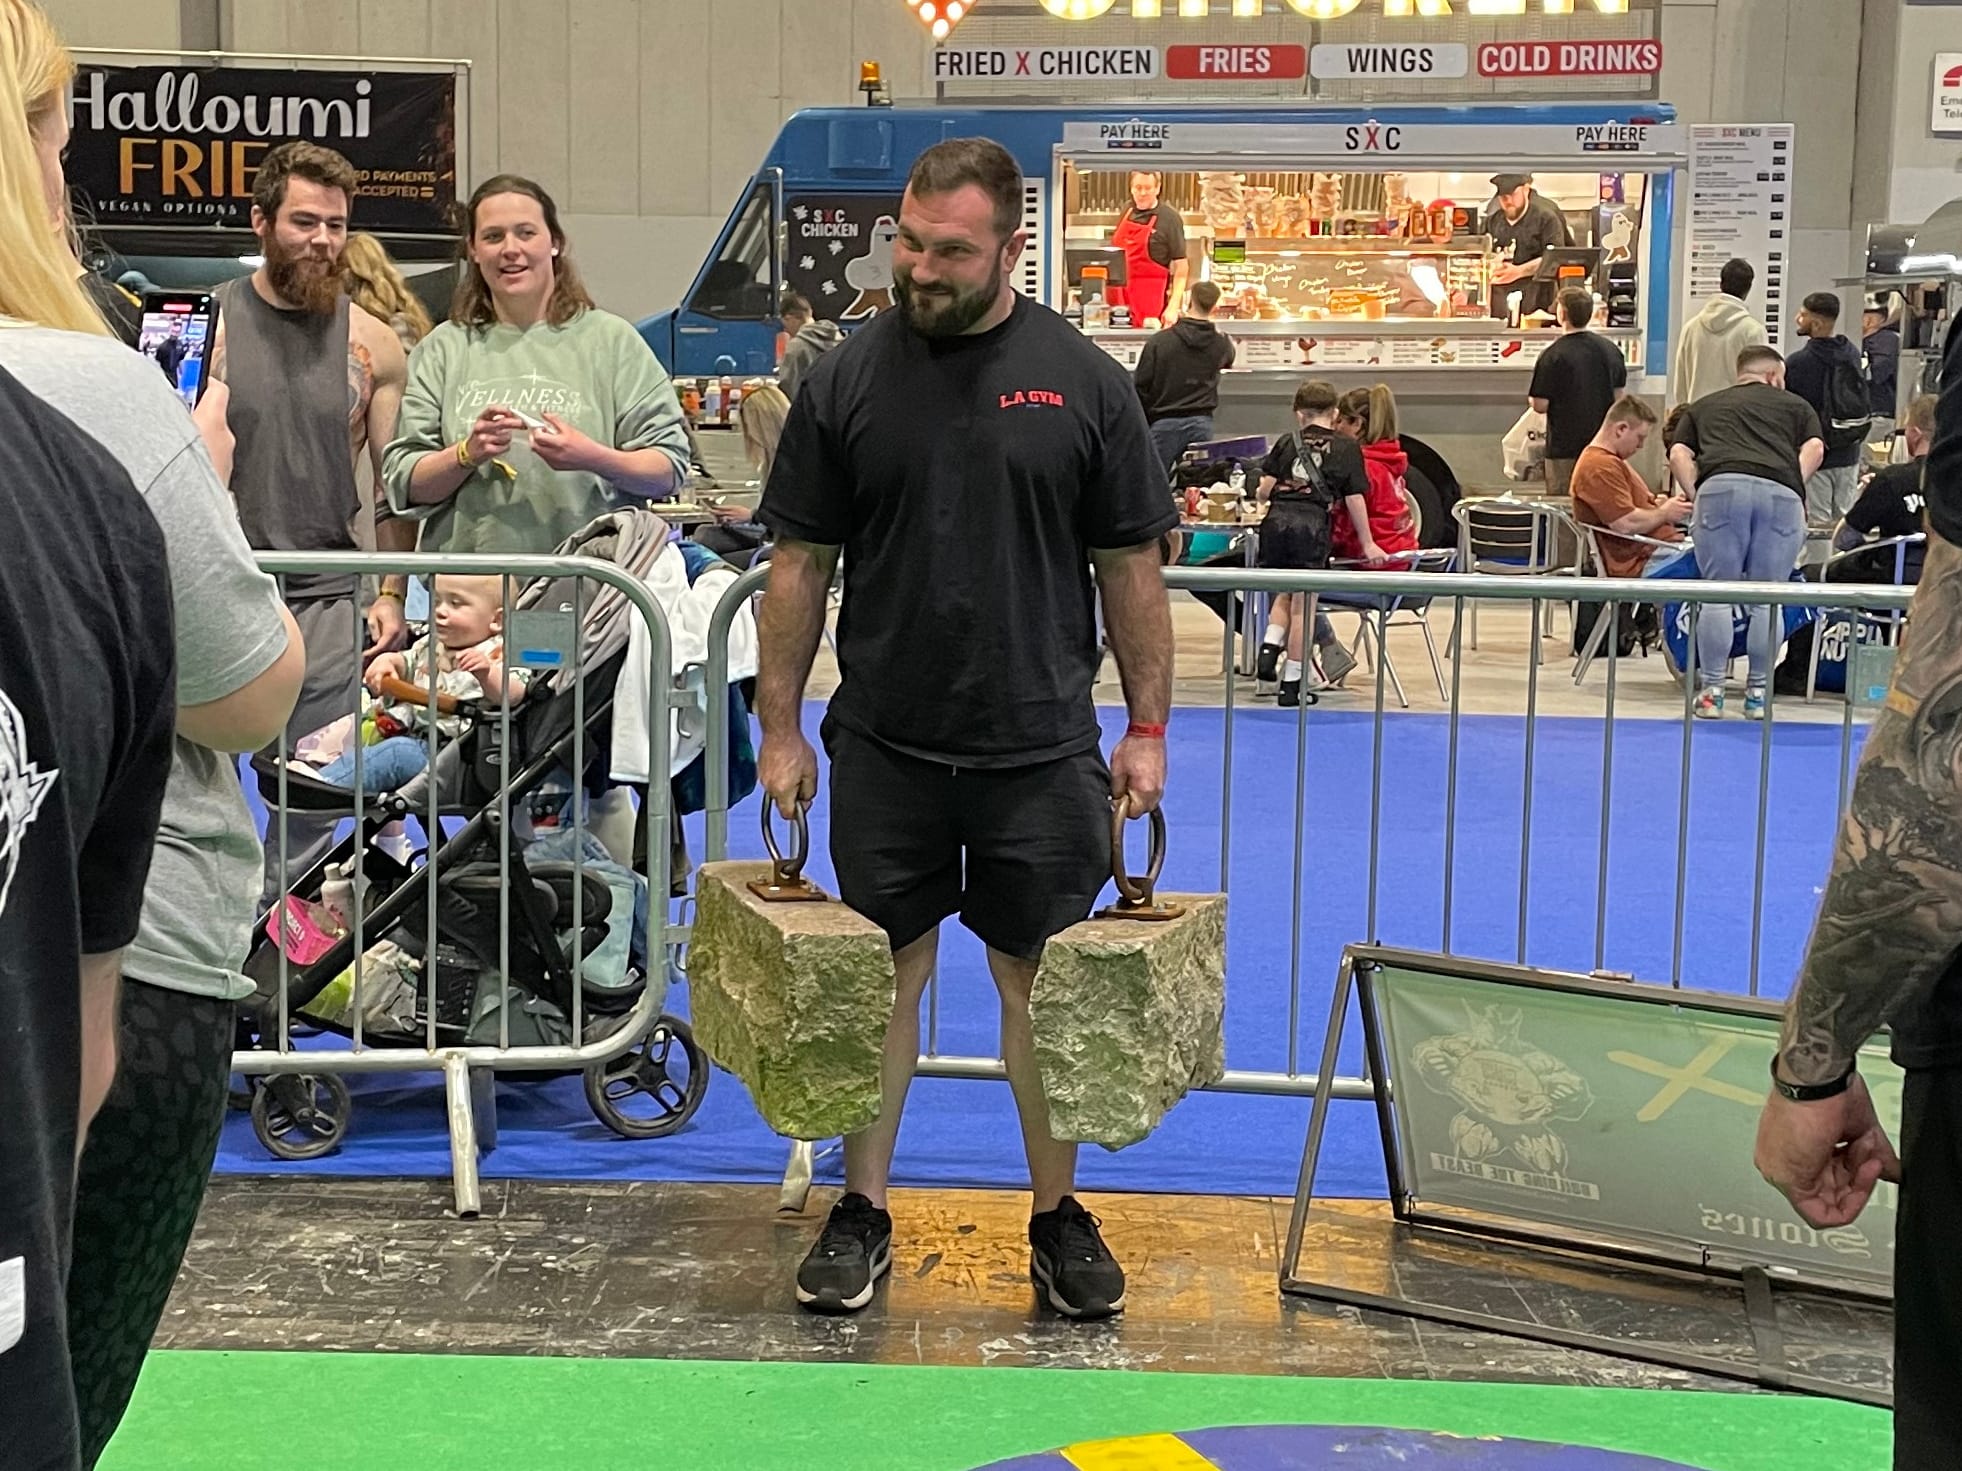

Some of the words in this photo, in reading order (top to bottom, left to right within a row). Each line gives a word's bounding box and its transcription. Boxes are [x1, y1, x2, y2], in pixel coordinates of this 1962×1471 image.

[935, 51, 1006, 76] FRIED
[1015, 51, 1031, 75] X
[1039, 50, 1151, 76] CHICKEN
[1199, 48, 1271, 73] FRIES
[1348, 47, 1434, 73] WINGS
[1481, 46, 1549, 72] COLD
[1560, 44, 1658, 71] DRINKS
[68, 71, 372, 138] Halloumi
[1100, 125, 1126, 139] PAY
[1131, 125, 1170, 140] HERE
[1576, 127, 1603, 141] PAY
[1608, 127, 1648, 142] HERE
[119, 138, 269, 198] FRIE
[373, 171, 436, 182] PAYMENTS
[353, 185, 419, 197] ACCEPTED
[99, 200, 152, 212] VEGAN
[163, 202, 237, 215] OPTIONS
[801, 223, 859, 237] CHICKEN
[1028, 390, 1063, 407] GYM
